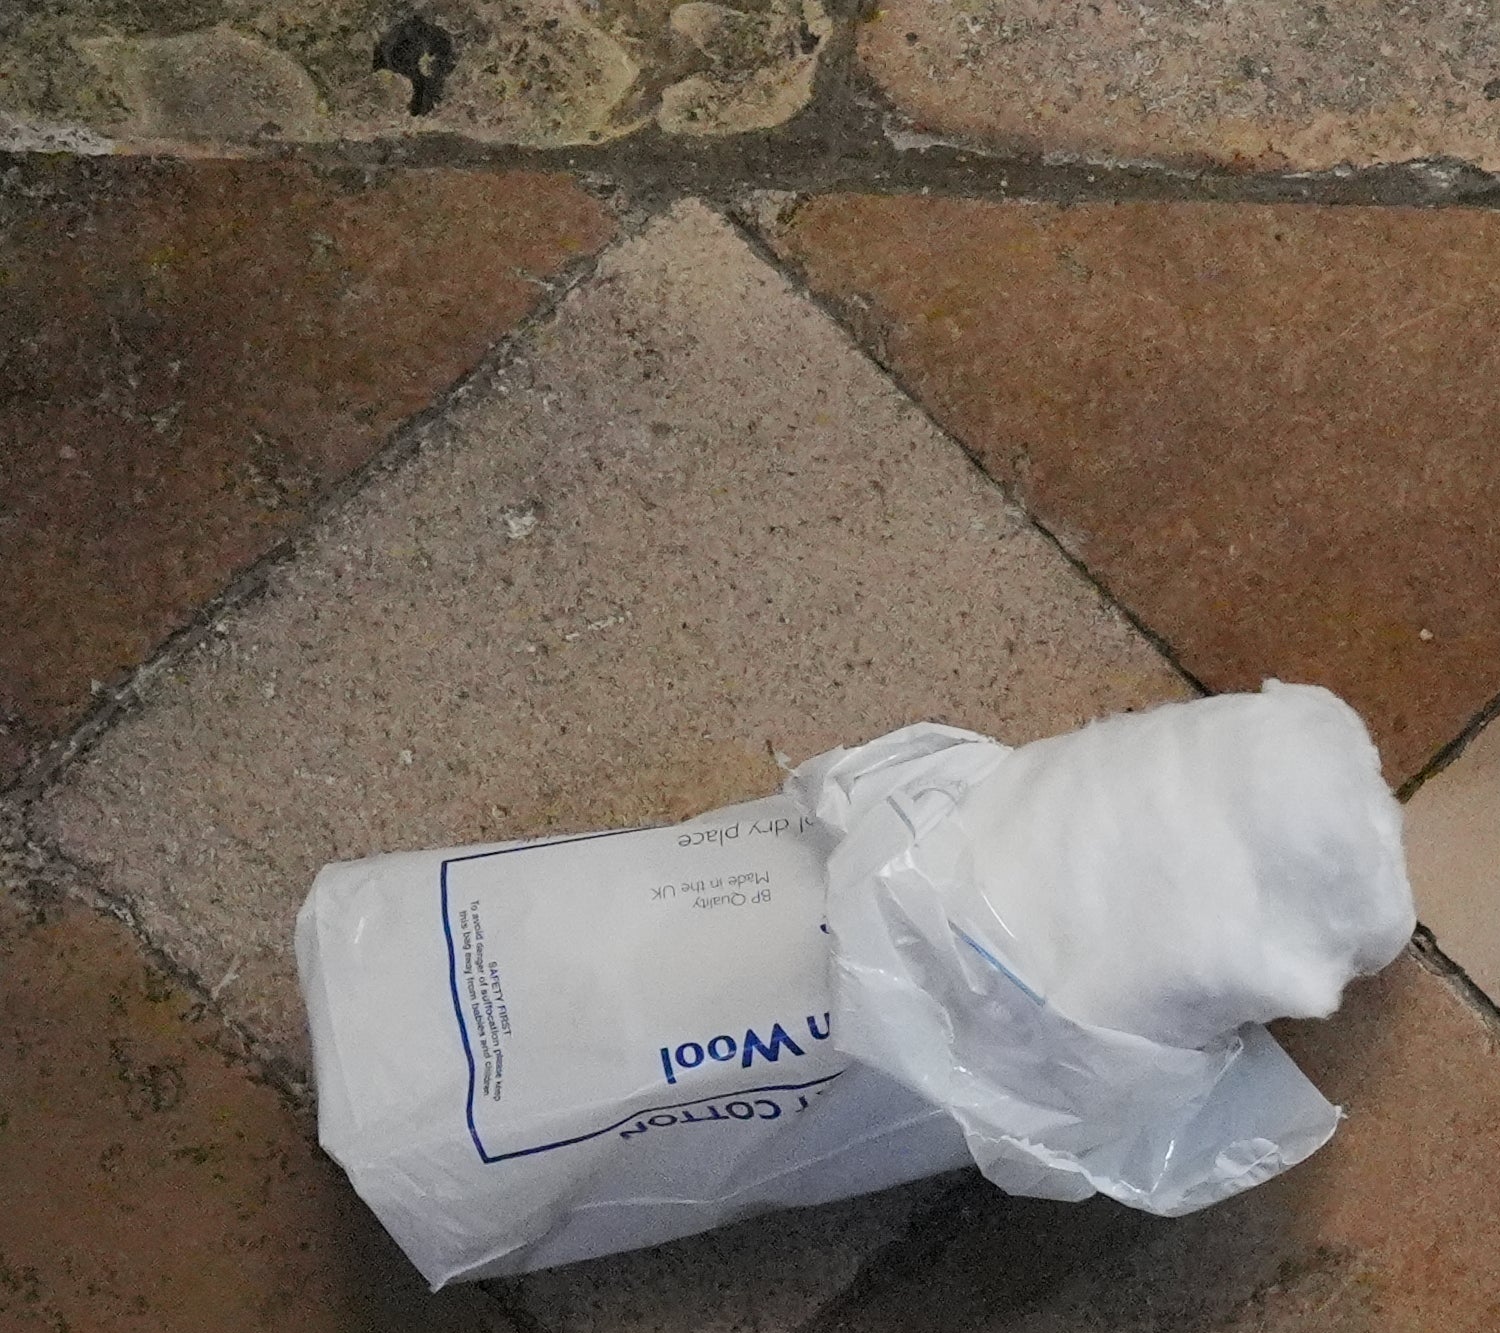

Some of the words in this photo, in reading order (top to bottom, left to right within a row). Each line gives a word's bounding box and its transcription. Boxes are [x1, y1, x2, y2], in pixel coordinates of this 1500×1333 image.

[678, 820, 740, 847] place
[749, 818, 790, 837] dry
[681, 879, 705, 893] the
[710, 877, 723, 890] in
[728, 871, 770, 887] Made
[651, 885, 676, 900] UK
[692, 892, 746, 909] Quality
[751, 888, 772, 904] BP
[470, 900, 480, 912] To
[471, 913, 484, 940] avoid
[474, 942, 484, 974] danger
[479, 976, 489, 987] of
[462, 931, 471, 950] bag
[480, 1039, 493, 1059] and
[488, 961, 504, 1001] SAFETY
[497, 1005, 512, 1037] FIRST
[481, 989, 500, 1047] suffocation
[660, 1023, 806, 1085] Wool
